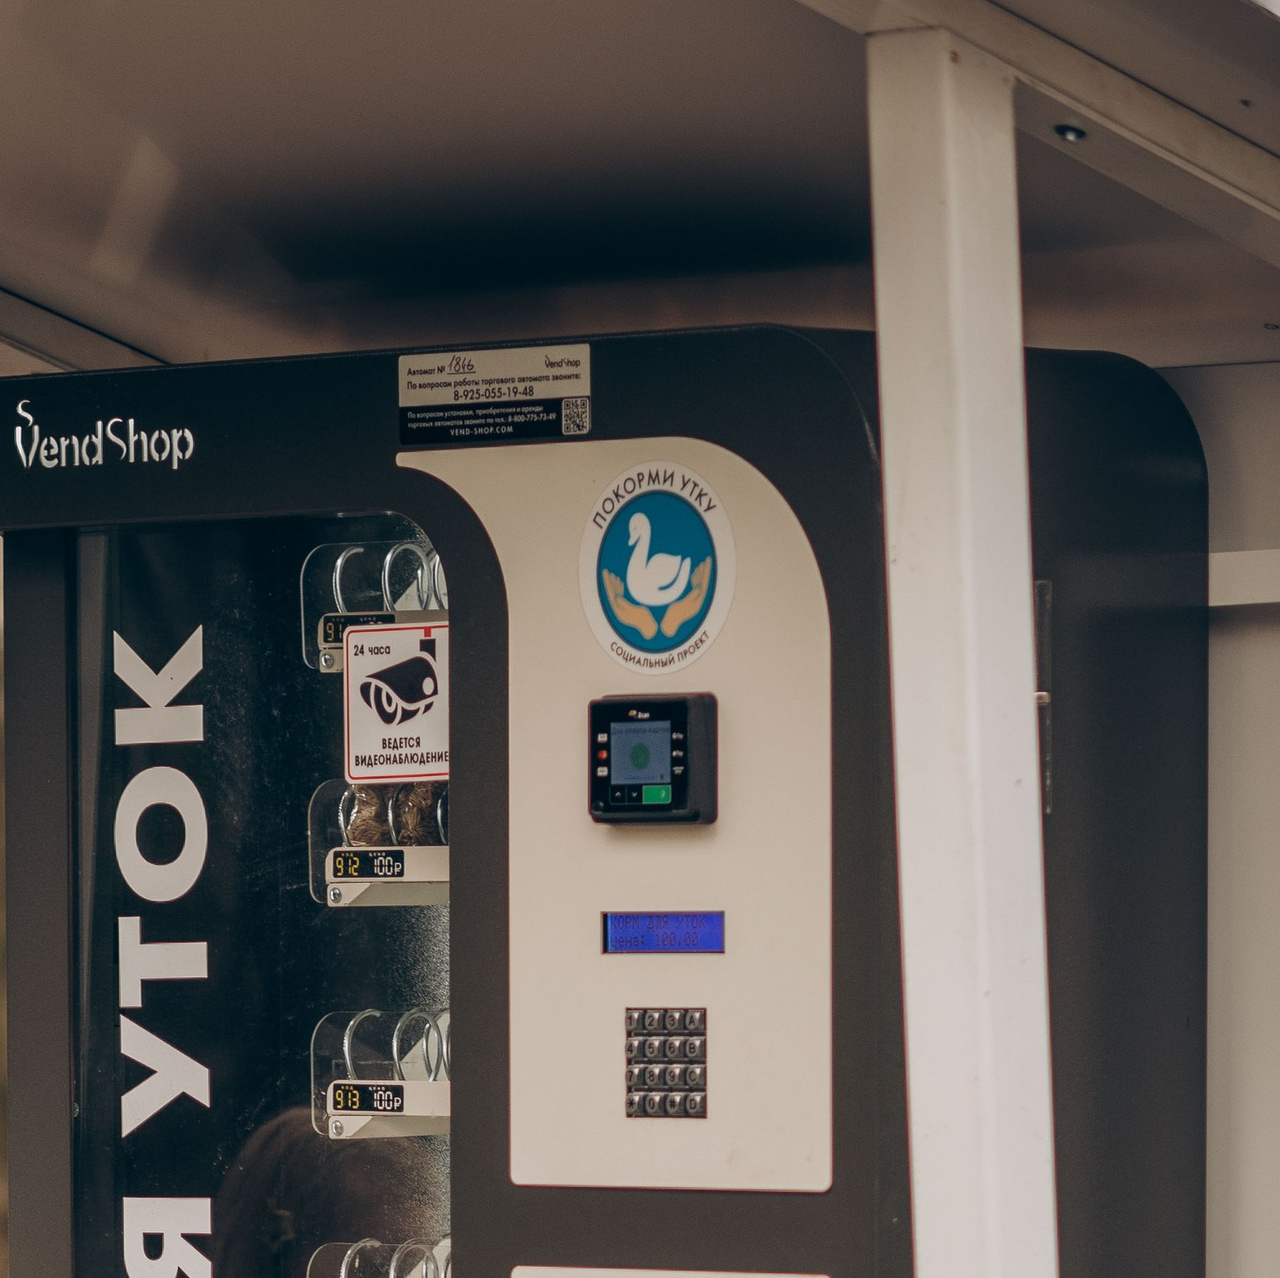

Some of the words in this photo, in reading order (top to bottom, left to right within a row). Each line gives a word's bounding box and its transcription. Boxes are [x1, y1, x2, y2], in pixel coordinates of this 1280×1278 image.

[407, 367, 435, 377] Автомат
[407, 381, 417, 390] По
[419, 381, 452, 391] вопросам
[454, 377, 479, 389] работы
[481, 376, 515, 386] торгового
[518, 375, 550, 383] автомата
[552, 373, 581, 382] звоните:
[453, 386, 534, 401] 8-925-055-19-48
[14, 400, 194, 469] VendShop
[450, 425, 514, 436] VEND-SHOP.COM
[592, 469, 675, 529] ПОКОРМИ
[681, 474, 717, 513] УТКУ
[353, 644, 365, 657] 24
[368, 645, 391, 656] часа
[610, 641, 675, 669] СОЦИАЛЬНЫЙ
[677, 630, 710, 662] ПРОЕКТ
[382, 736, 421, 750] ВЕДЕТСЯ
[355, 751, 450, 768] ВИДЕОНАБЛЮДЕНИЕ
[336, 857, 359, 876] 912
[113, 624, 211, 1138] УТОК
[627, 1015, 632, 1026] 1
[648, 1015, 655, 1027] 2
[669, 1015, 675, 1027] 3
[688, 1015, 696, 1026] A
[627, 1043, 634, 1054] 4
[648, 1043, 655, 1055] 5
[669, 1042, 675, 1054] 6
[689, 1043, 696, 1053] B
[627, 1070, 633, 1082] 7
[648, 1070, 655, 1082] 8
[669, 1070, 675, 1082] 9
[689, 1070, 697, 1082] C
[336, 1090, 359, 1109] 913
[648, 1098, 655, 1110] 0
[689, 1098, 697, 1109] D
